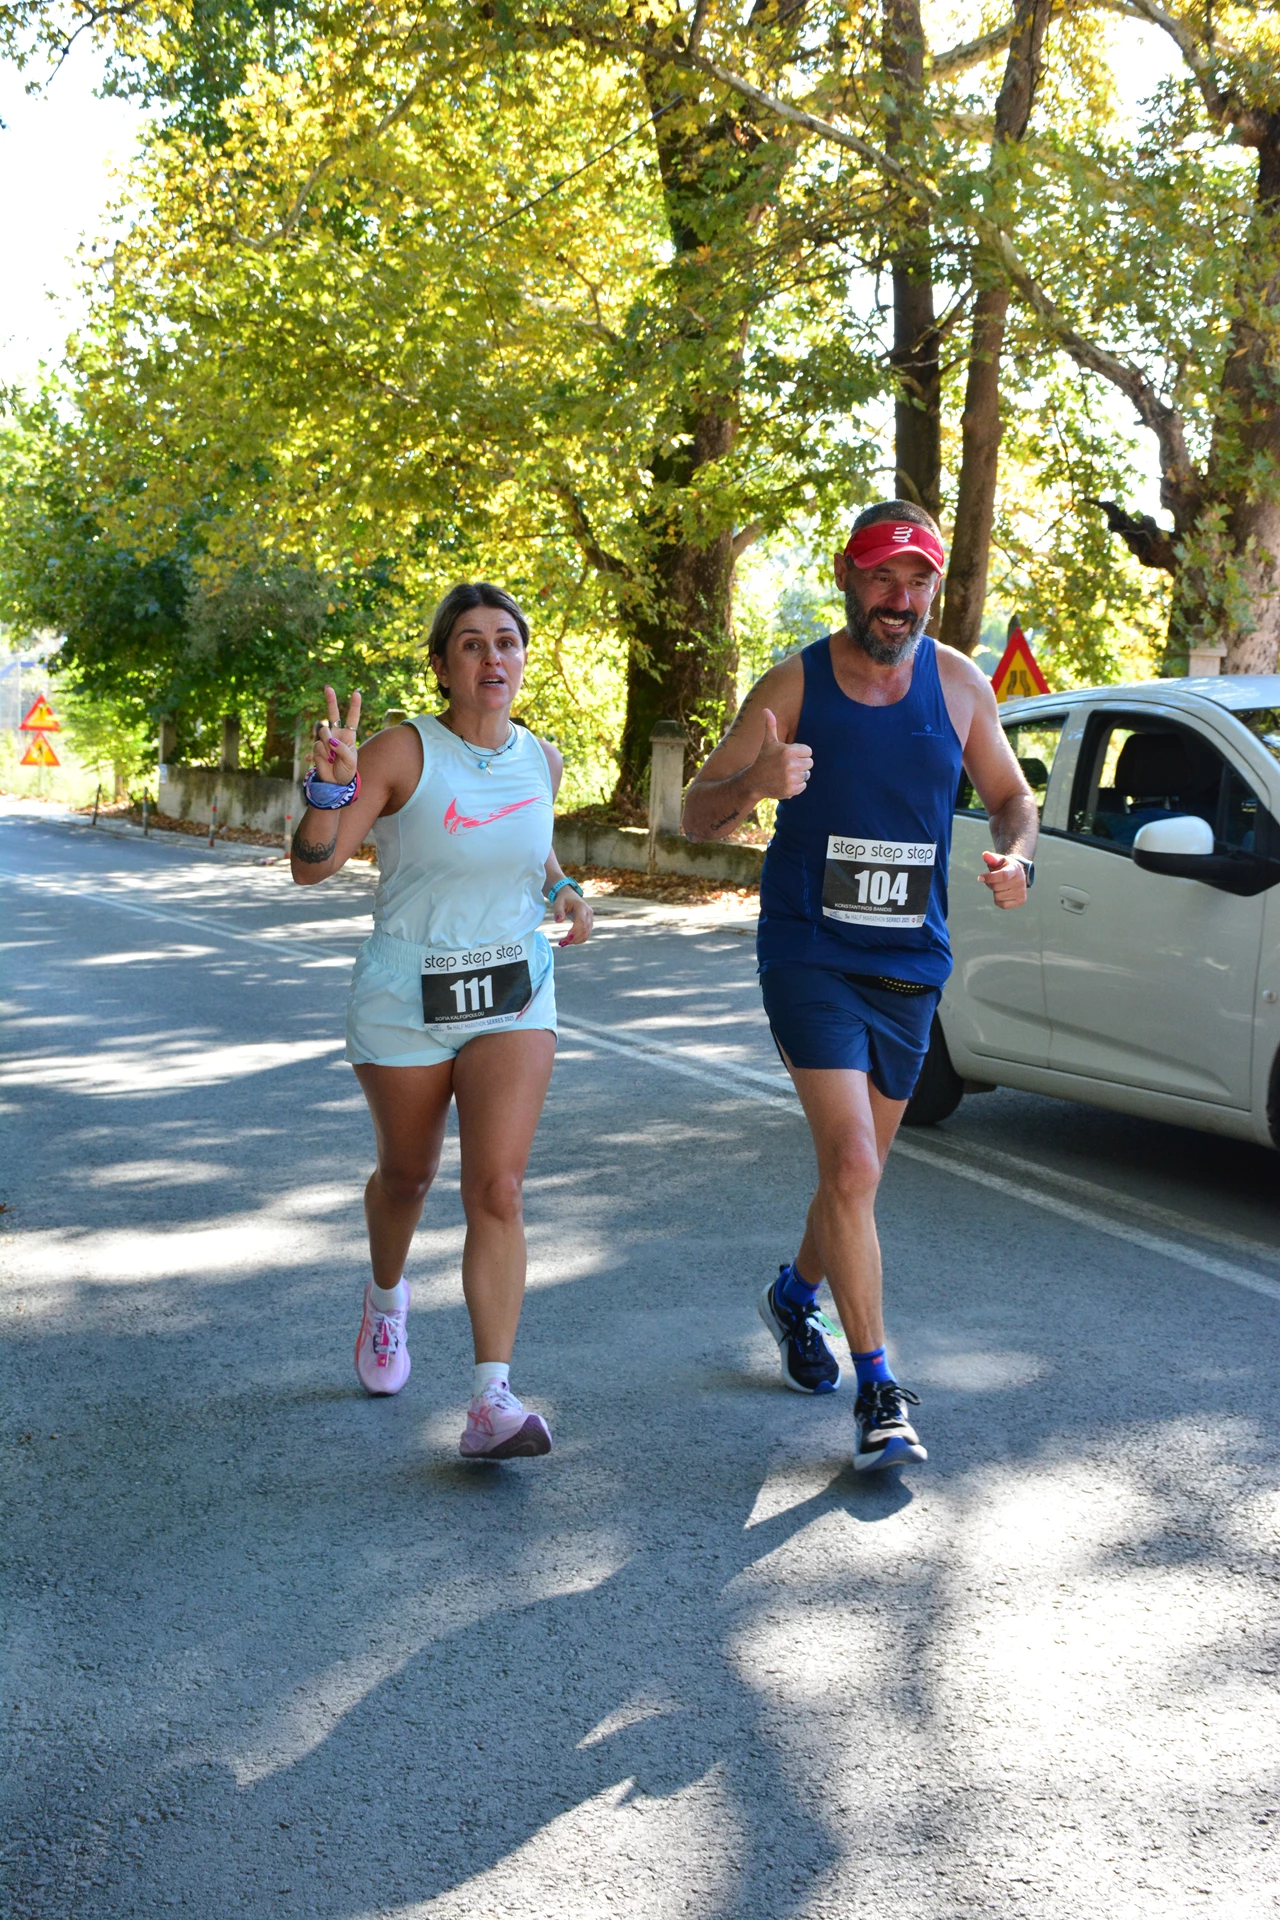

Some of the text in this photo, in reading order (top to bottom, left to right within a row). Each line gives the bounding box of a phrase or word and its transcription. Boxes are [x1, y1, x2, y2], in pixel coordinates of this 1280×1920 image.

[833, 840, 933, 863] step step step
[854, 870, 909, 906] 104
[424, 944, 523, 971] step step step
[449, 974, 493, 1013] 111
[487, 1018, 504, 1026] SERRES
